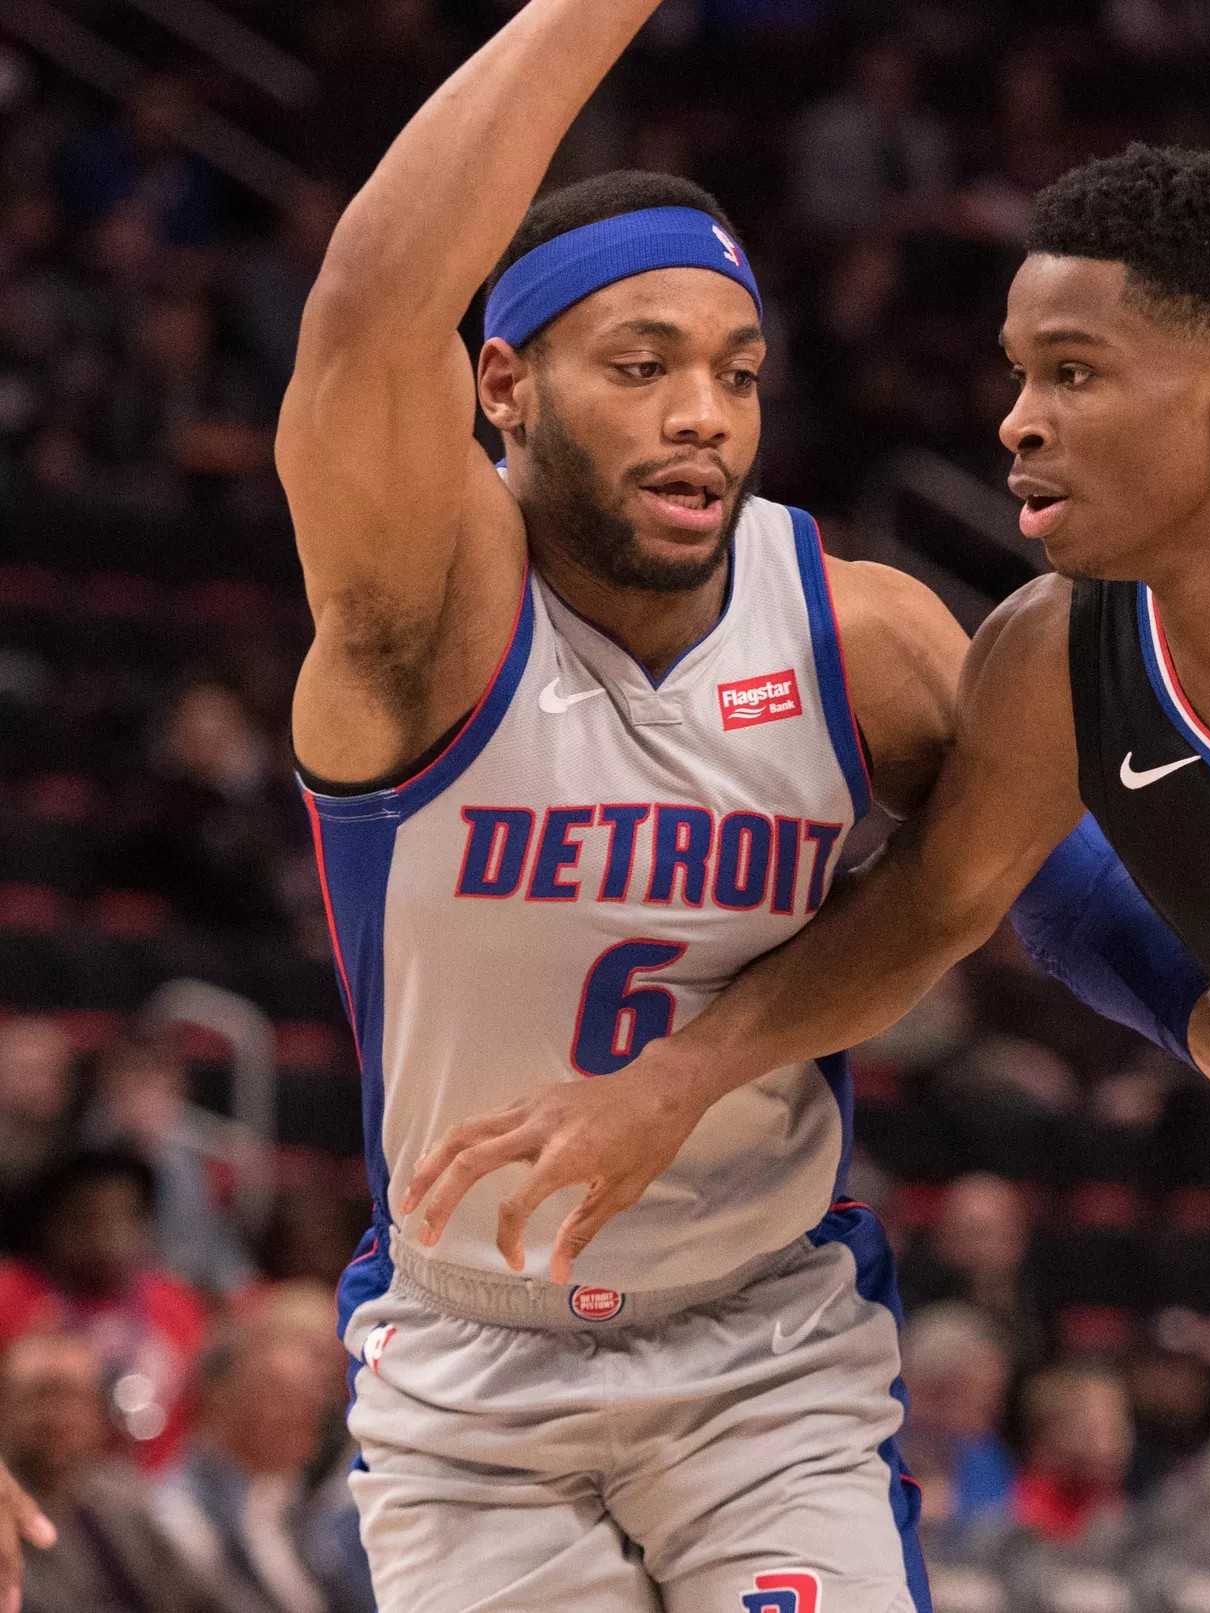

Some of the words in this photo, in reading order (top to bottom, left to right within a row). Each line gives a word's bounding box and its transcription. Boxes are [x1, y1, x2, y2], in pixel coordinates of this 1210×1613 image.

[722, 681, 792, 707] Flagstar
[769, 700, 796, 713] Bank
[454, 803, 844, 915] DETROIT
[570, 938, 688, 1077] 6
